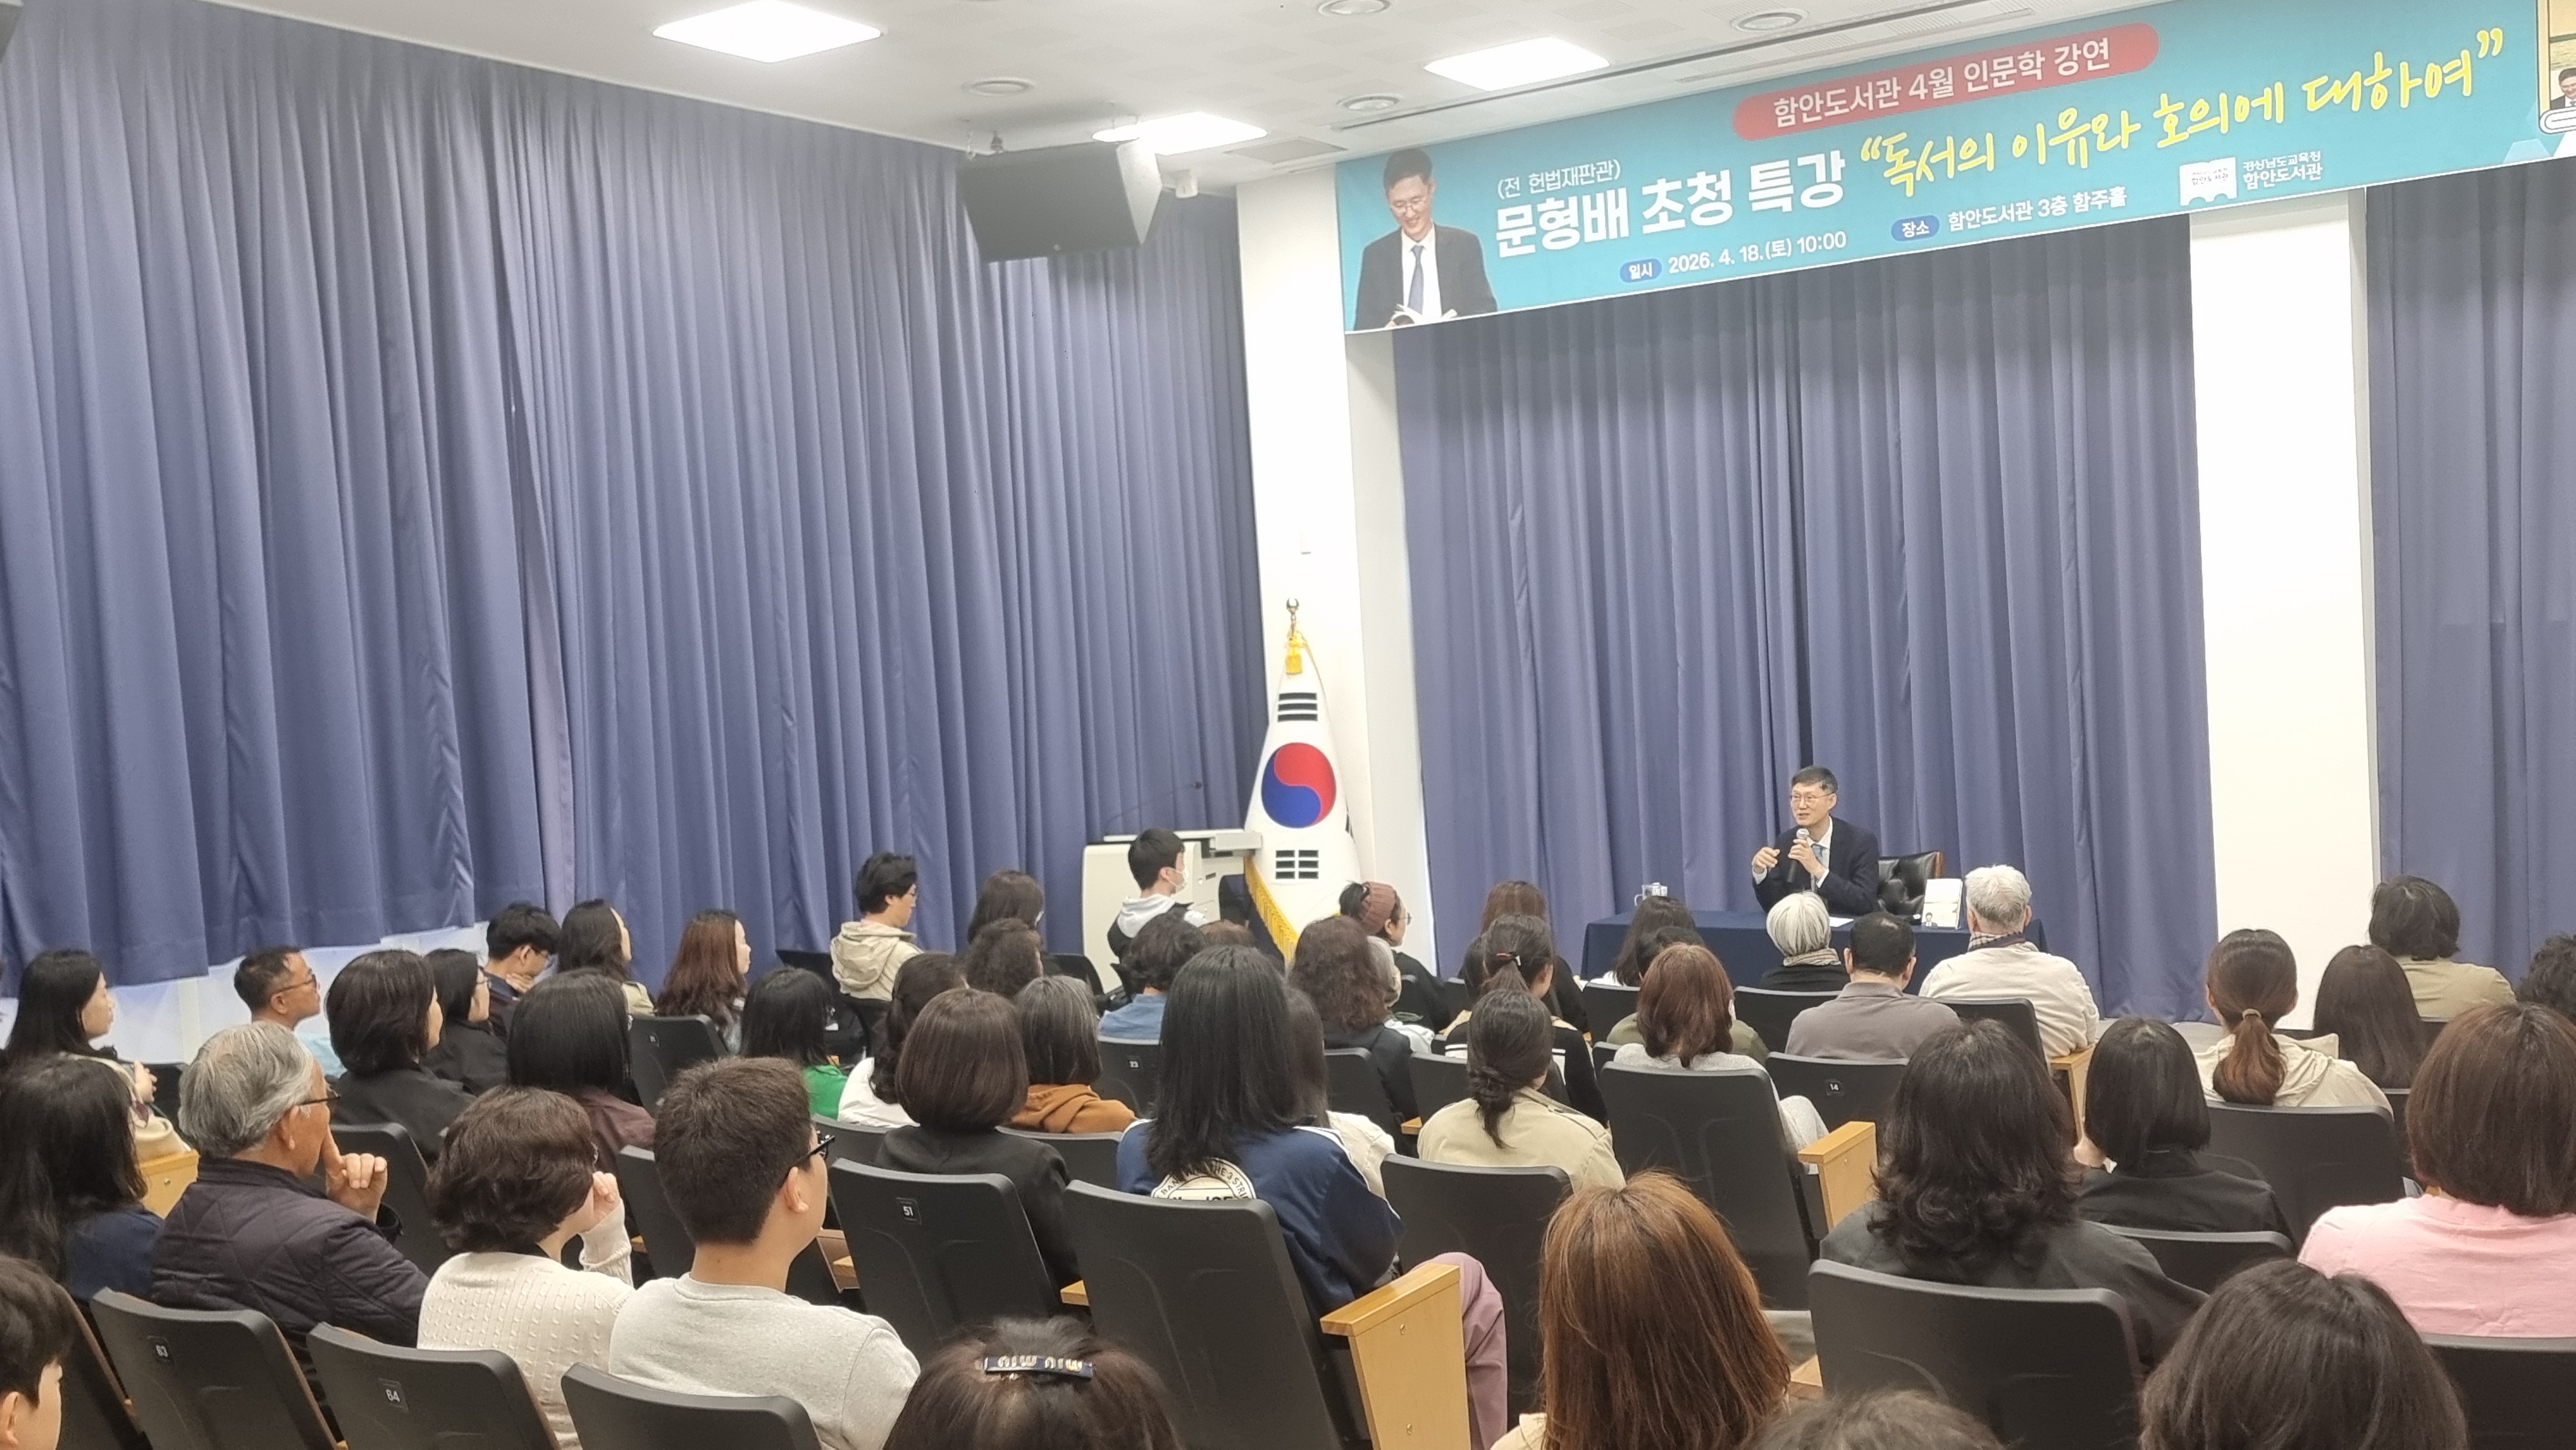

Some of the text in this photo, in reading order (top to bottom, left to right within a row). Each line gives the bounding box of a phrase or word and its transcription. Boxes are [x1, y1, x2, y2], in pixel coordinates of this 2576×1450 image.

[1774, 37, 2110, 128] 함안도서관 4월 인문학 강연
[2012, 107, 2142, 169] 이유와
[2153, 82, 2284, 149] 호의에
[1498, 159, 1621, 200] (전 헌법재판관)
[2242, 151, 2321, 171] 경상남도교육청
[2242, 162, 2323, 190] 함안도서관
[1496, 150, 1846, 258] 문형배 초청 특강
[1902, 186, 2127, 238] 장소 함안도서관 3층 함주홀
[1629, 262, 1653, 278] 일시
[1669, 252, 1714, 274] 2026.
[1719, 249, 1734, 265] 4.
[1797, 231, 1846, 254] 10:00
[903, 1205, 913, 1216] 51
[386, 1389, 400, 1402] 64
